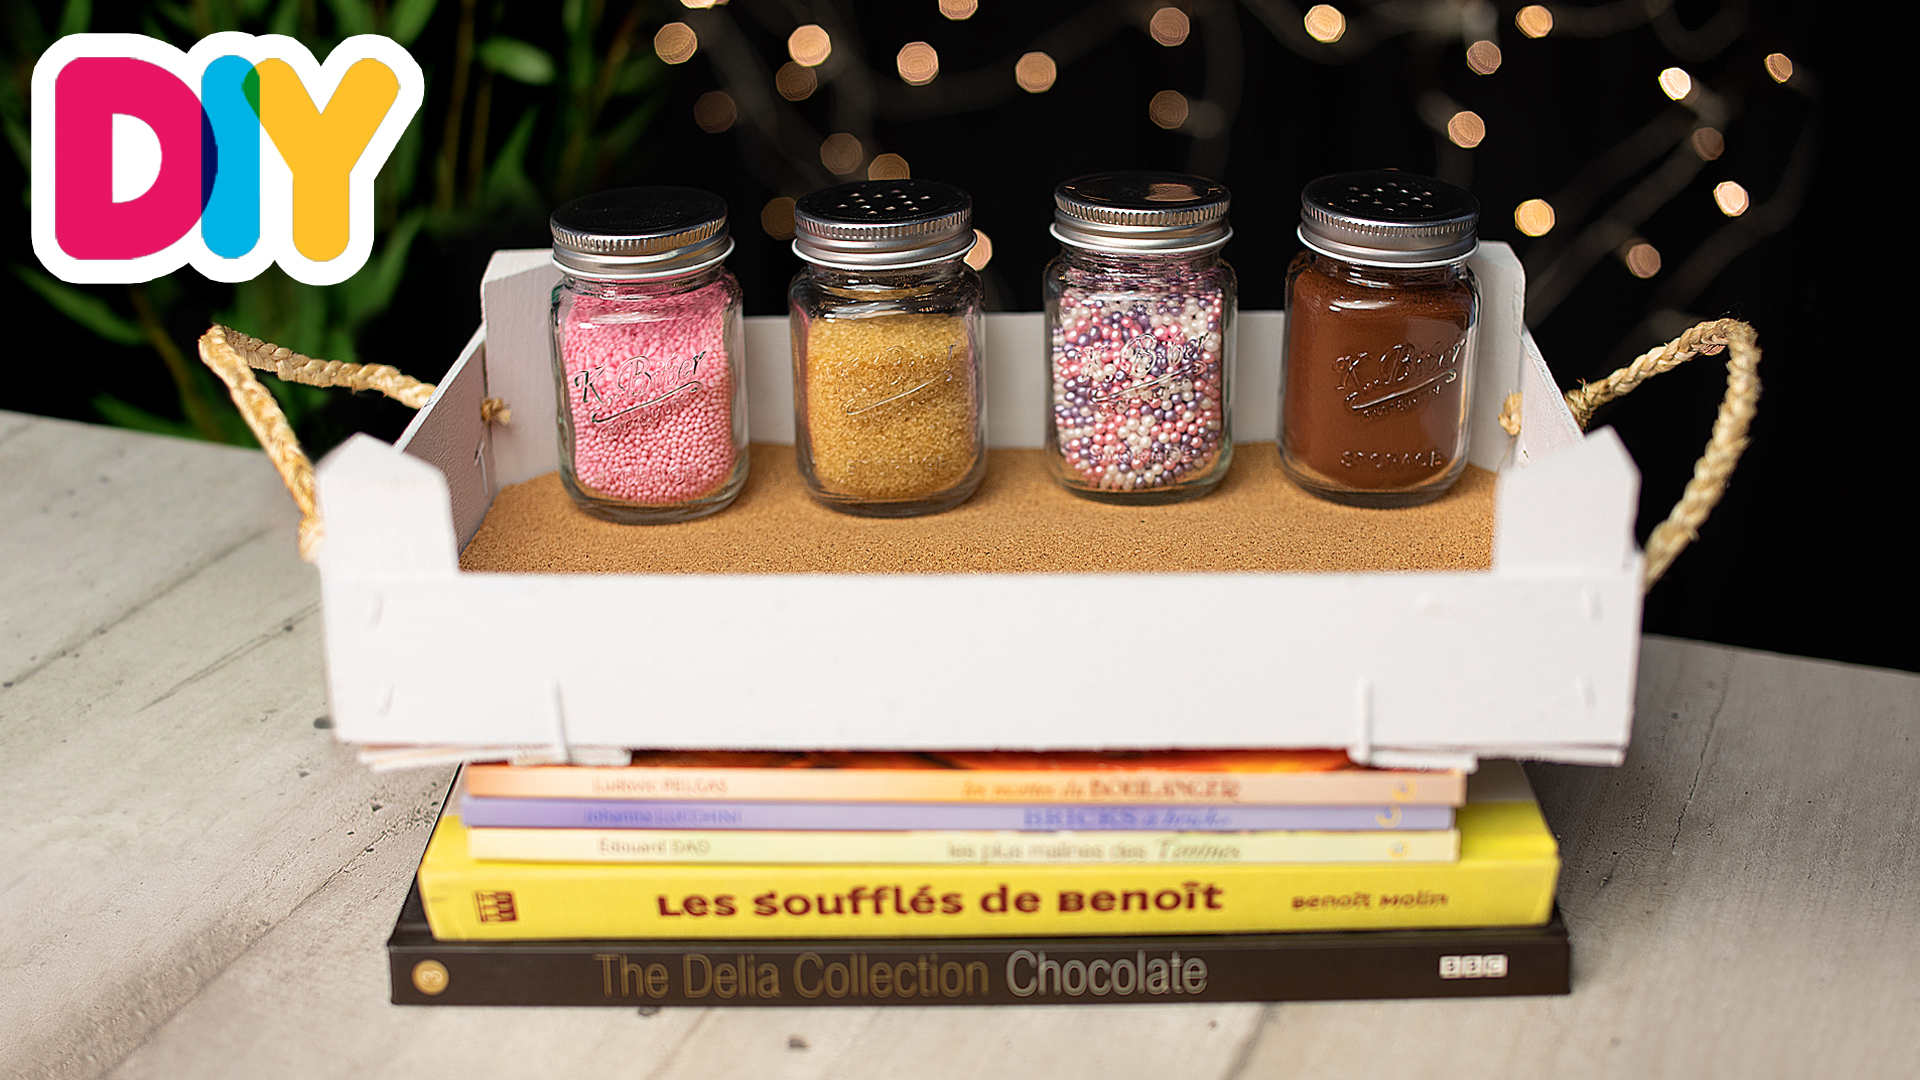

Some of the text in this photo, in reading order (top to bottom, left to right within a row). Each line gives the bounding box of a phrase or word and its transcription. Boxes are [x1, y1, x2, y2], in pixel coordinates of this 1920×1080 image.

[980, 884, 1041, 914] de
[593, 950, 990, 1000] The Delia Collection
[1006, 948, 1209, 998] Chocolate
[1439, 954, 1509, 980] BBC
